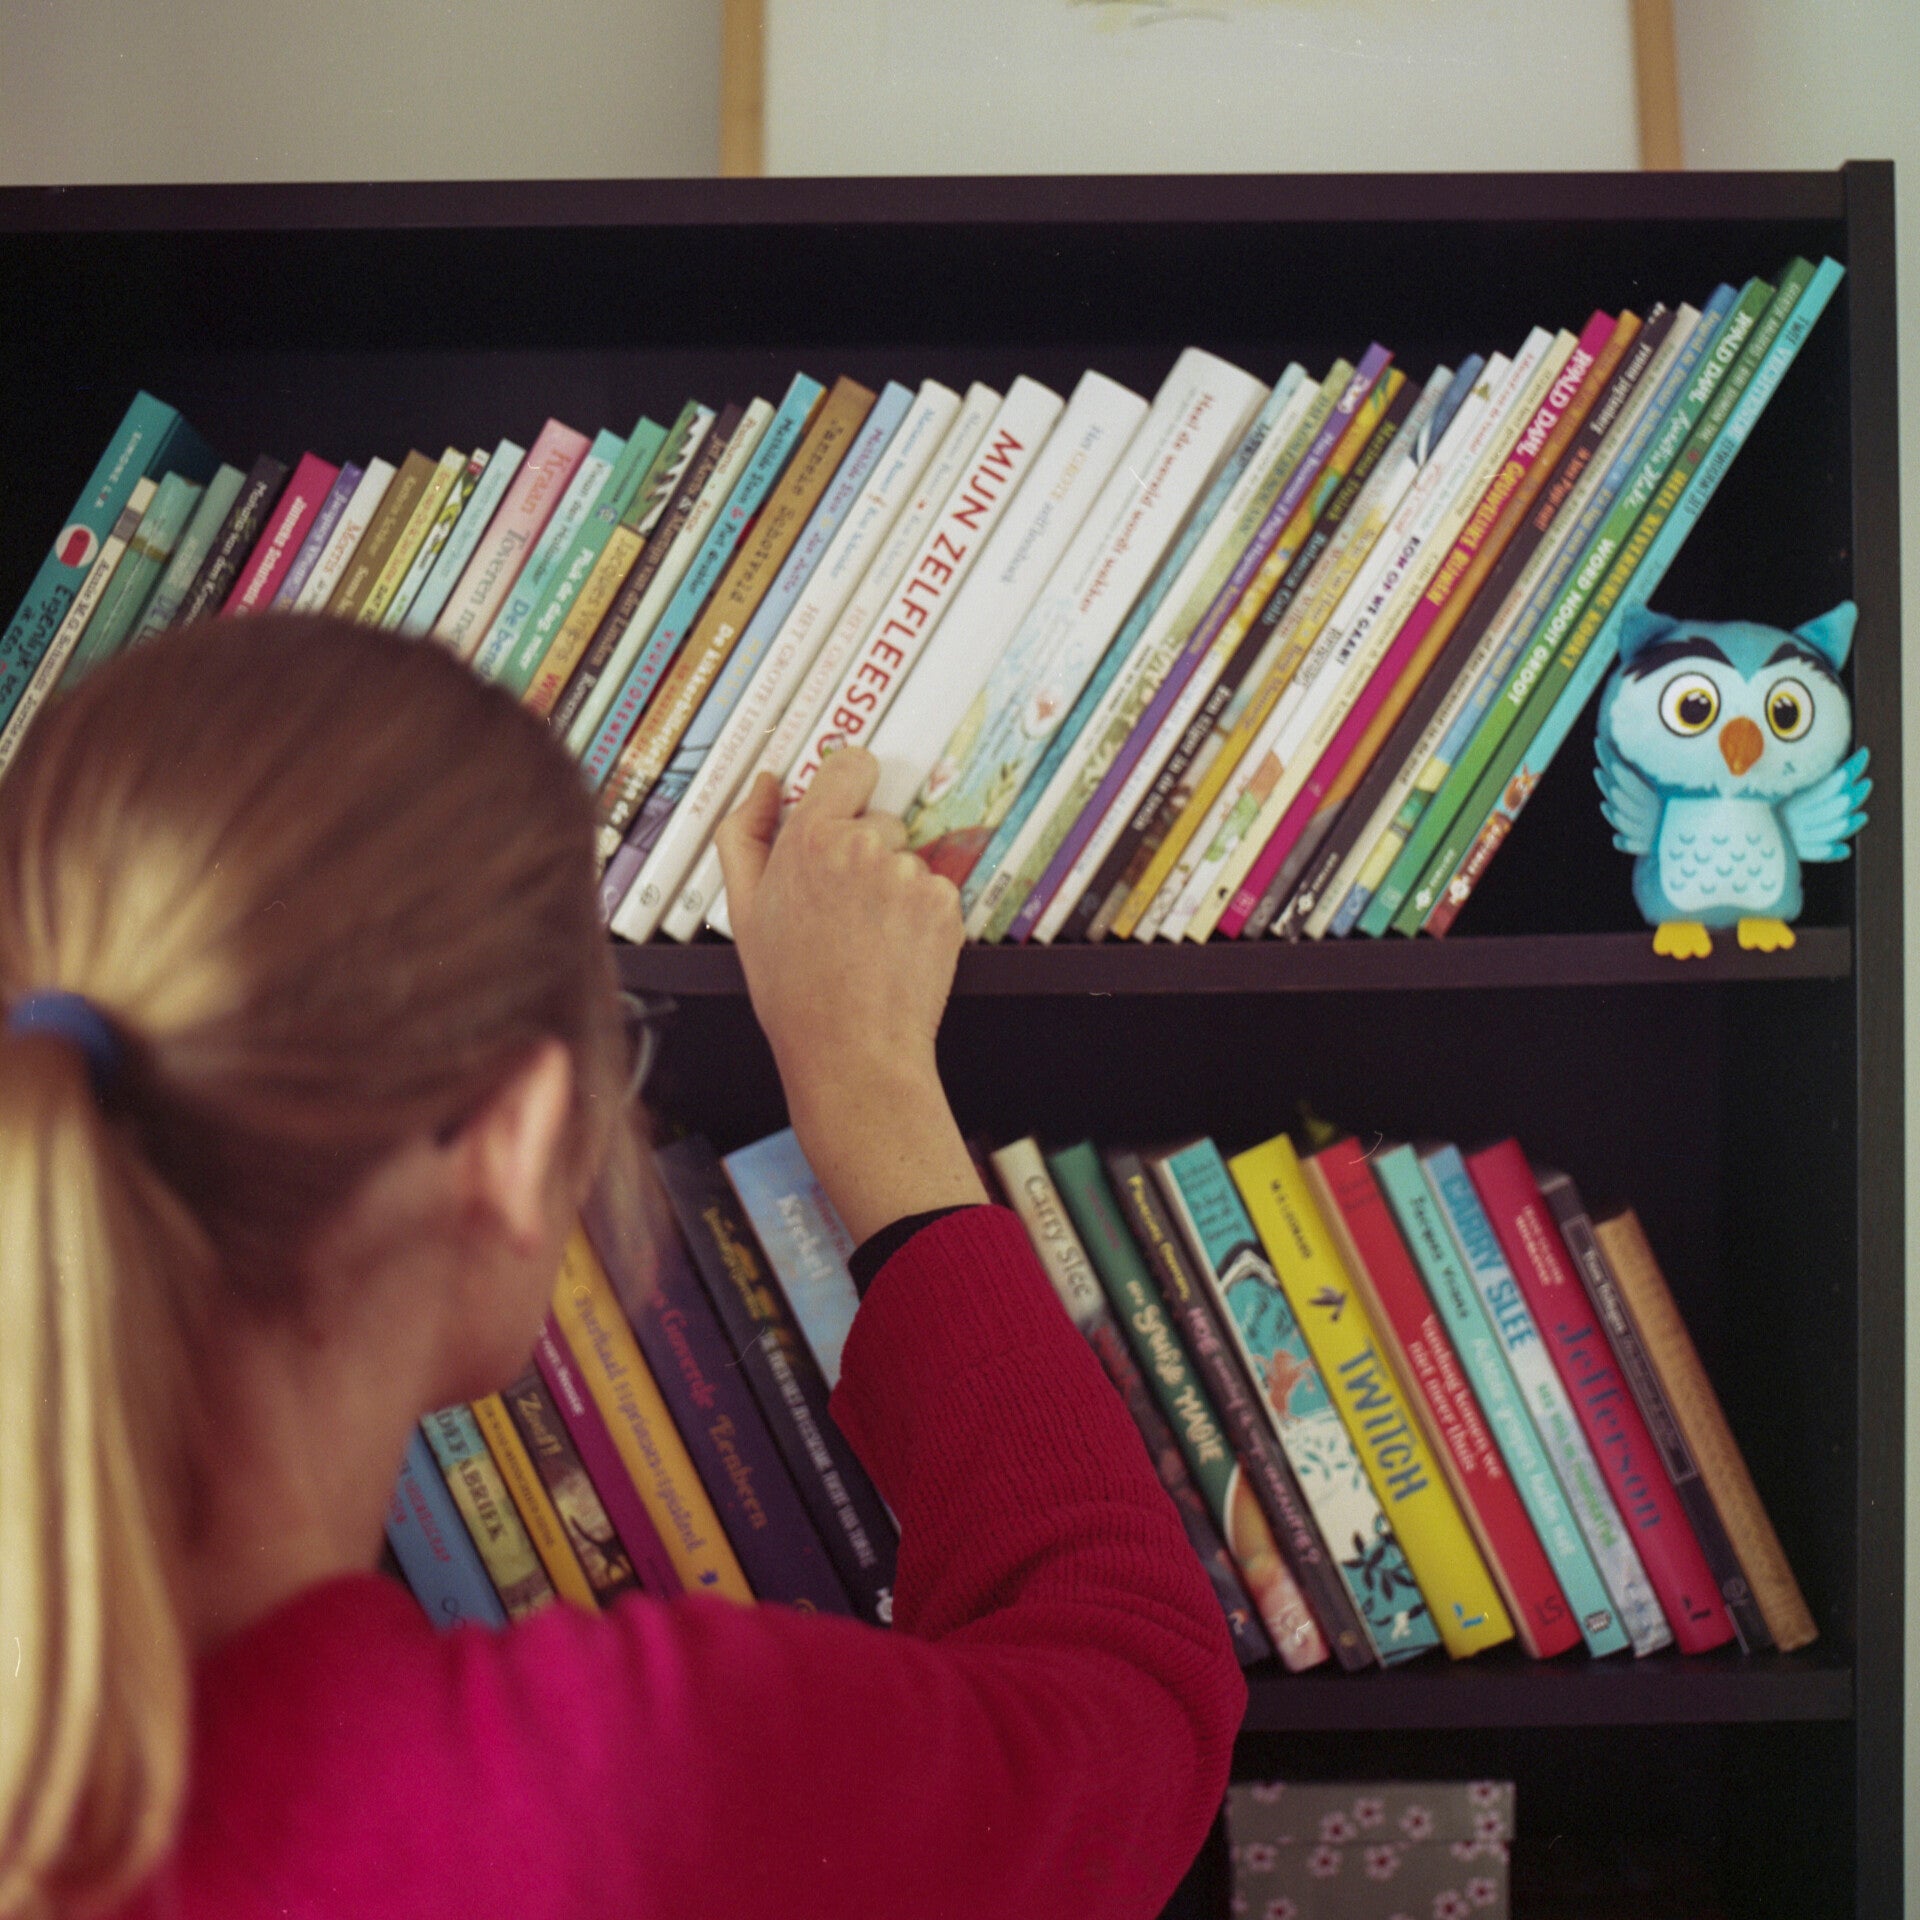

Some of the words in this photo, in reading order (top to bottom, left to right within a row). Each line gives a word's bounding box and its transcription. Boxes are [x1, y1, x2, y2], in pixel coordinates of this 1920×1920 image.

[1711, 309, 1755, 365] ROALD
[1783, 314, 1810, 346] TWEE
[1546, 347, 1594, 410] ROALD
[1686, 359, 1724, 407] DAHL
[1076, 422, 1104, 453] Het
[1183, 390, 1216, 431] Heel
[1514, 407, 1558, 461] DAHL
[789, 418, 844, 500] Janneke
[1170, 428, 1194, 455] de
[519, 447, 572, 519] Kraan
[948, 426, 1028, 532] MIJN
[1048, 448, 1088, 502] GROTE
[1139, 452, 1181, 509] wereld
[1655, 468, 1687, 509] HEEL
[728, 505, 744, 522] &
[1111, 507, 1149, 557] wordt
[467, 522, 531, 610] Toveren
[566, 546, 594, 581] Pluk
[586, 537, 634, 608] Jacques
[728, 504, 795, 607] Schotveld
[1573, 535, 1617, 592] WORD
[504, 598, 529, 628] De
[554, 579, 575, 604] de
[1076, 555, 1121, 618] wakker
[1540, 588, 1585, 647] NOOIT
[751, 642, 797, 706] GROTE
[1206, 687, 1230, 715] Een
[1504, 643, 1551, 707] GROOT
[1176, 712, 1211, 754] tijger
[1155, 772, 1174, 793] de
[1168, 754, 1187, 774] in
[775, 1190, 833, 1282] Krekel
[1018, 1173, 1069, 1244] Carry
[1053, 1242, 1098, 1301] Slee
[1439, 1171, 1502, 1277] CARRY
[1485, 1277, 1534, 1351] SLEE
[1407, 1339, 1434, 1379] niet
[1424, 1377, 1453, 1425] meer
[1417, 1312, 1463, 1392] Vandaag
[1452, 1386, 1493, 1453] komen
[1481, 1451, 1502, 1479] we
[1329, 1337, 1435, 1503] TWITCH
[1553, 1310, 1675, 1531] Jefferson
